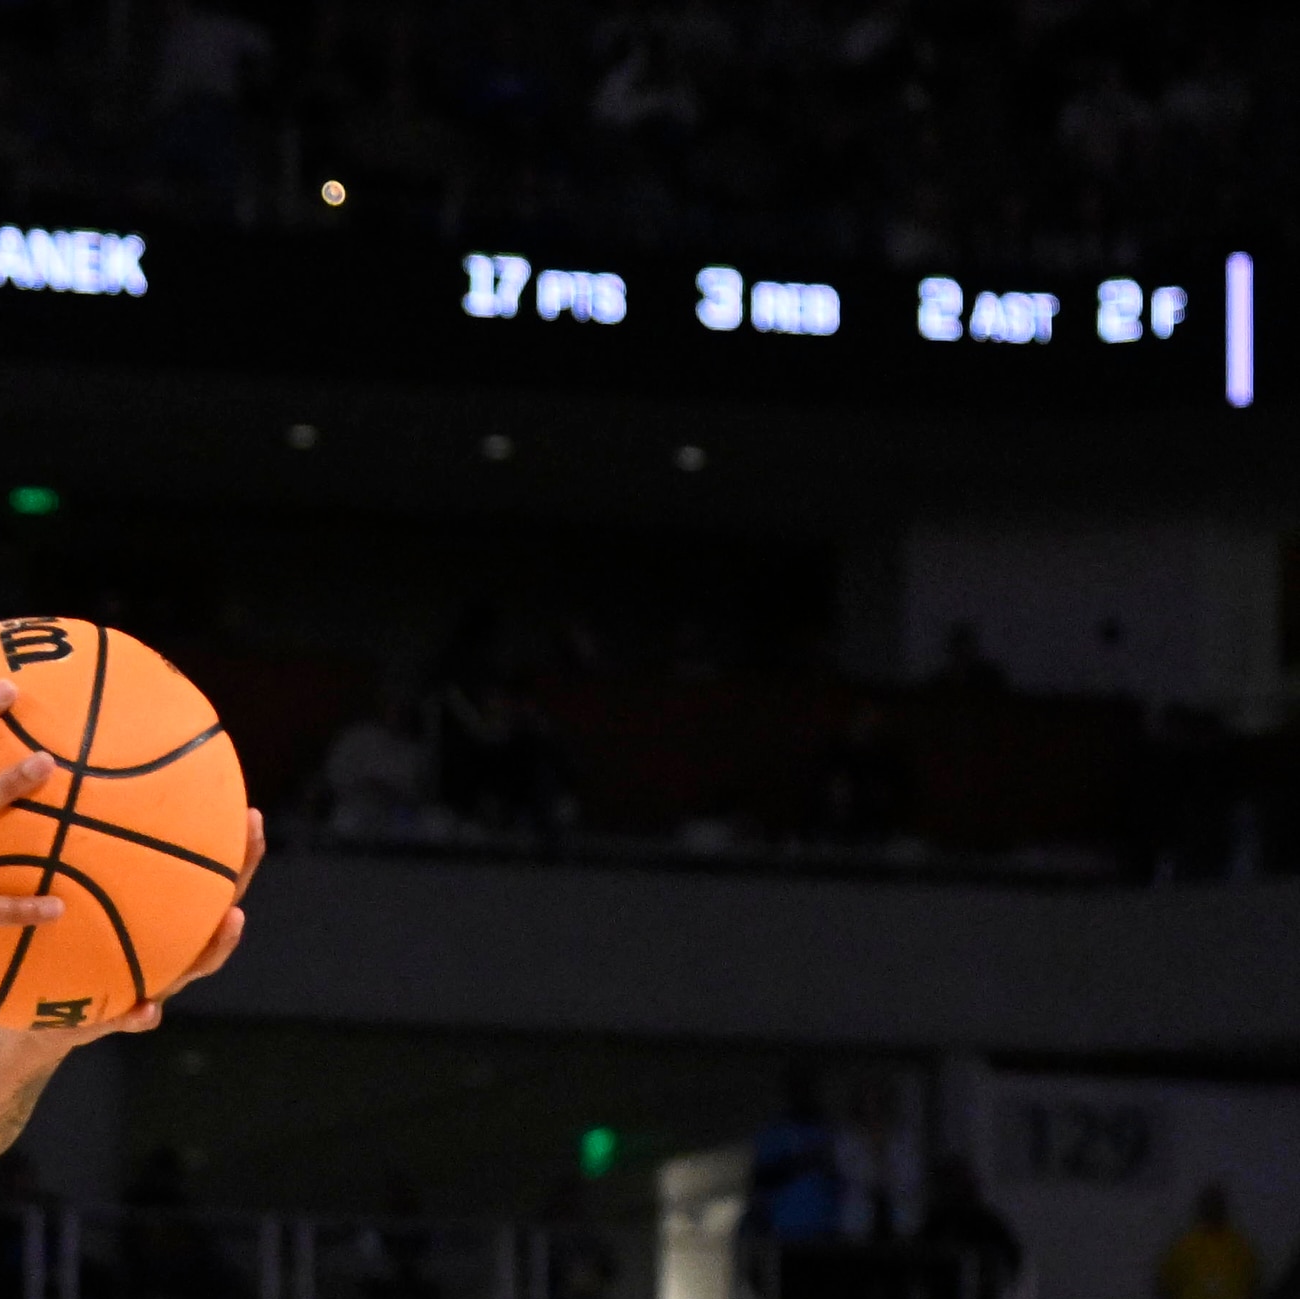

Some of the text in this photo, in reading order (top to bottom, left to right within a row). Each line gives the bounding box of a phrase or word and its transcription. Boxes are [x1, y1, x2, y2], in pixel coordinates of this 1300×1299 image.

[461, 253, 532, 319] 17
[696, 265, 744, 331] 3
[918, 275, 963, 342] 2
[1097, 275, 1143, 344] 2
